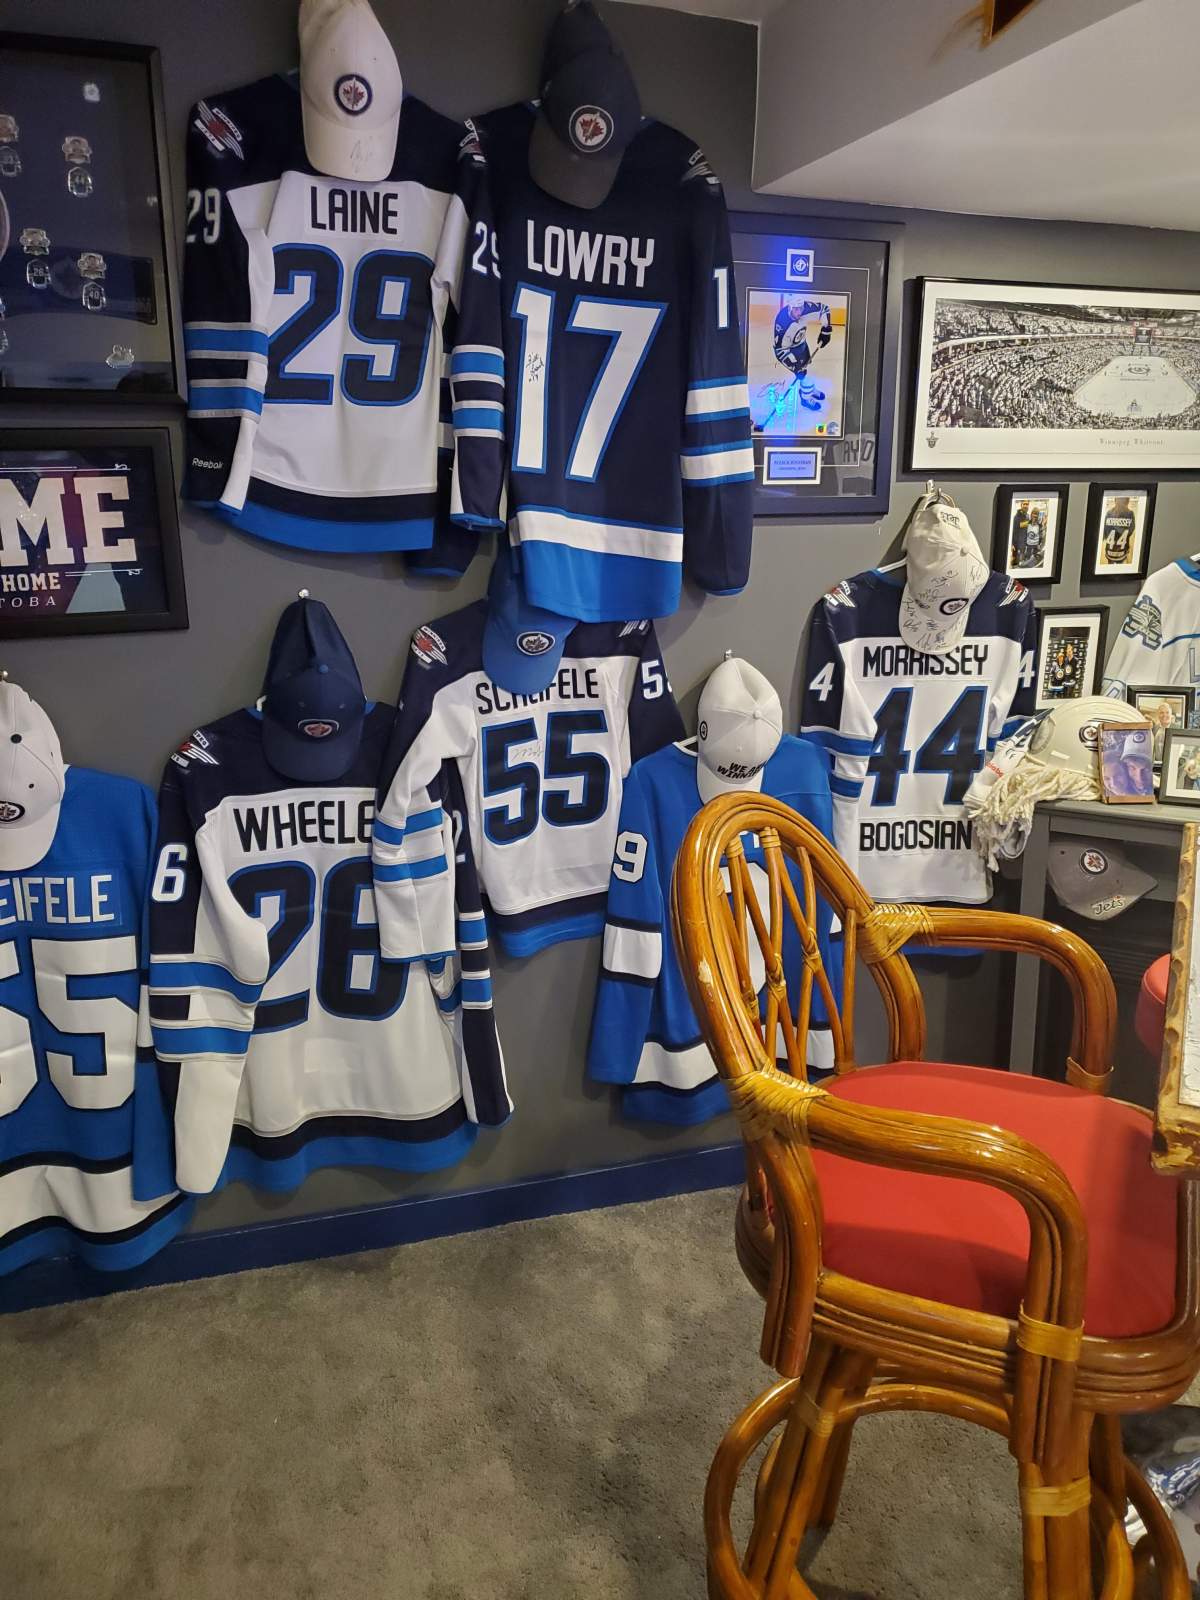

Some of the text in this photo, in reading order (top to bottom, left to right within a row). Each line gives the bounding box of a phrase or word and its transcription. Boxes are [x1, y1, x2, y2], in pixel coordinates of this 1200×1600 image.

[186, 188, 221, 244] 29
[310, 186, 399, 235] LAINE
[526, 218, 656, 288] LOWRY
[264, 242, 436, 407] 29
[510, 281, 671, 484] 17
[1106, 529, 1130, 550] 44
[2, 572, 62, 593] HOME
[809, 662, 836, 702] 4
[1018, 650, 1036, 688] 4
[728, 762, 748, 773] WE
[866, 686, 989, 807] 44
[481, 709, 611, 846] 55
[233, 800, 376, 853] WHEELE
[859, 820, 973, 852] BOGOSIAN
[151, 844, 188, 902] 6
[611, 831, 649, 884] 9
[227, 855, 411, 1035] 26
